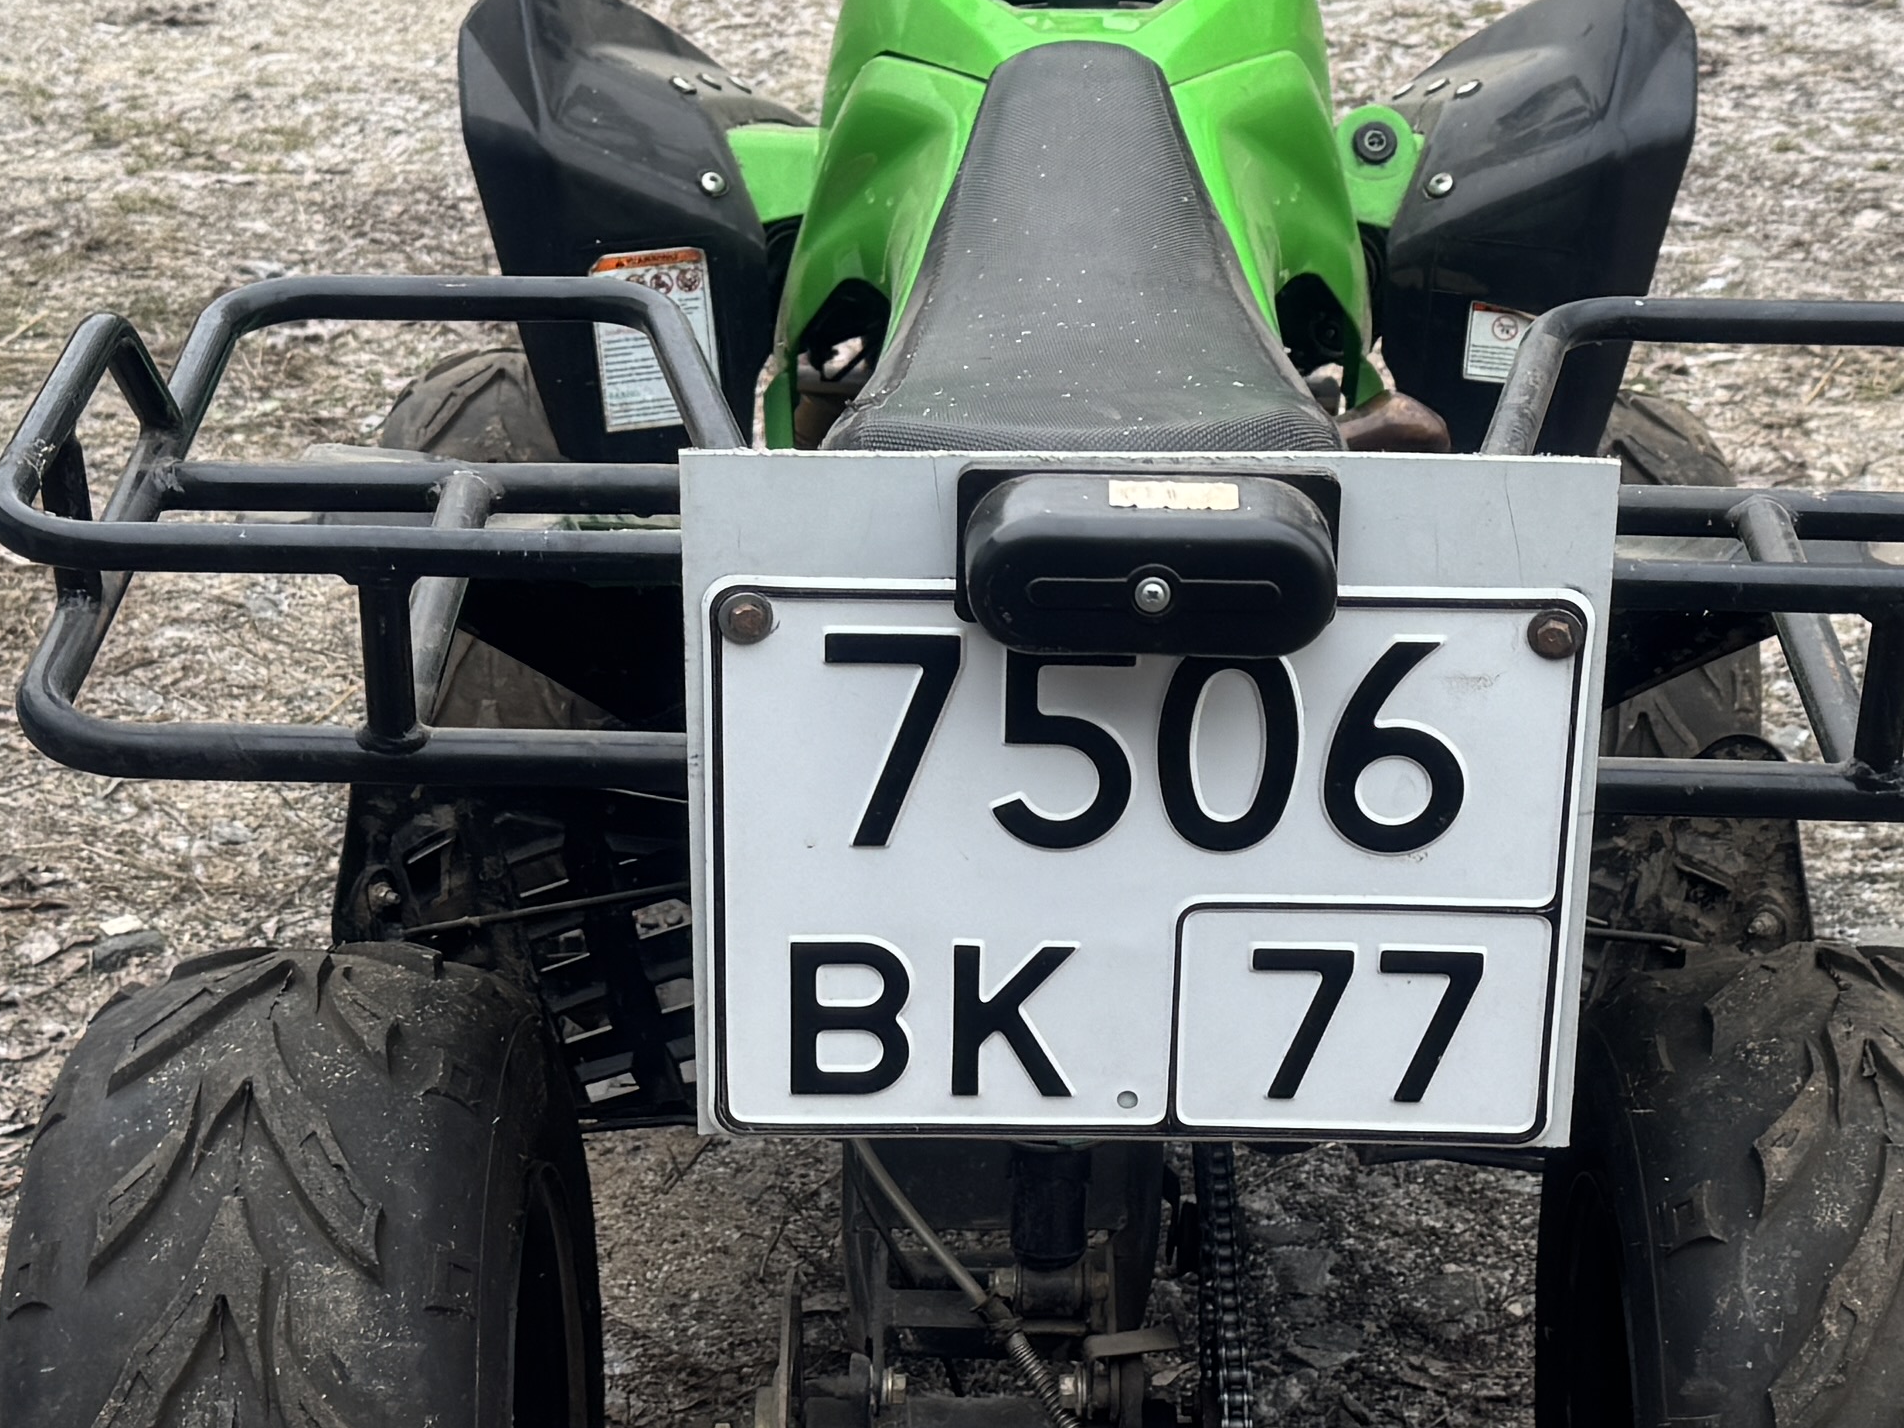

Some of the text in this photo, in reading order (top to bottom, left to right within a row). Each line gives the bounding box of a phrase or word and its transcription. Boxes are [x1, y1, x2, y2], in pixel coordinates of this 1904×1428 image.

[823, 632, 1467, 853] 7506
[789, 939, 1487, 1103] ВК 77
